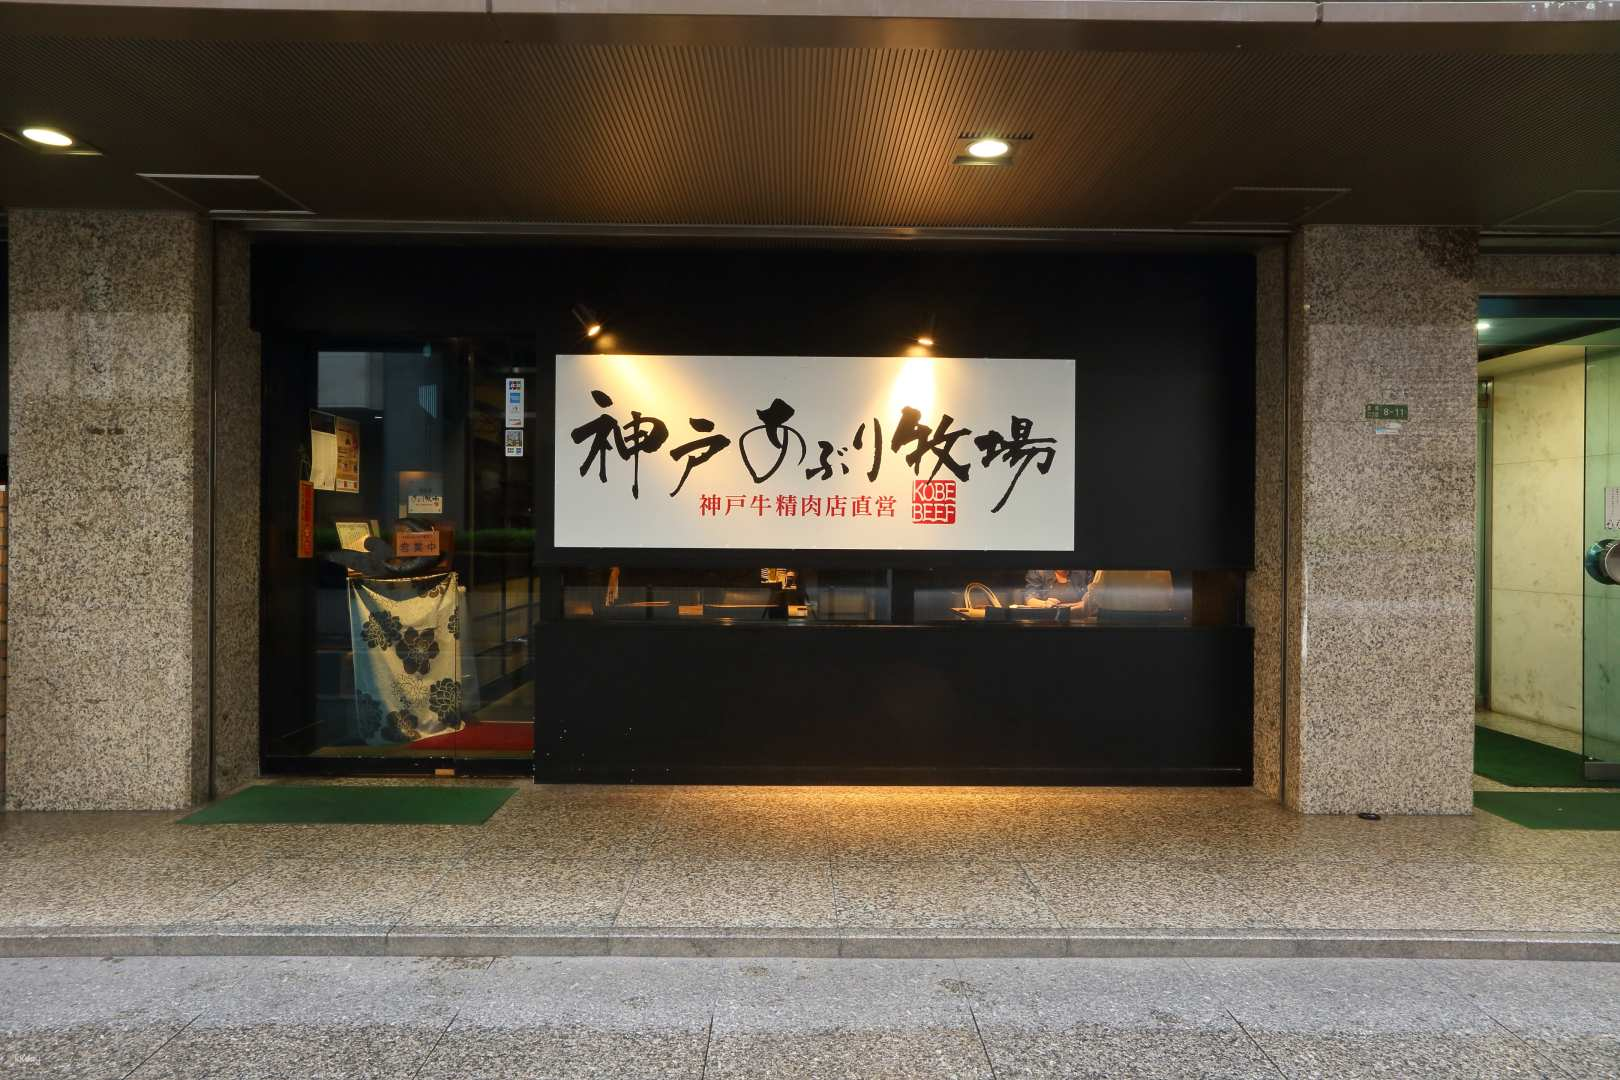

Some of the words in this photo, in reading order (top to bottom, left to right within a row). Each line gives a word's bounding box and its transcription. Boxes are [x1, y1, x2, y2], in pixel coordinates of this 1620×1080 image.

[571, 390, 1057, 513] 神戸あぶり牧場
[912, 482, 956, 502] KOBE
[699, 494, 897, 517] 神戸牛精肉店直営
[912, 503, 956, 523] BEEF
